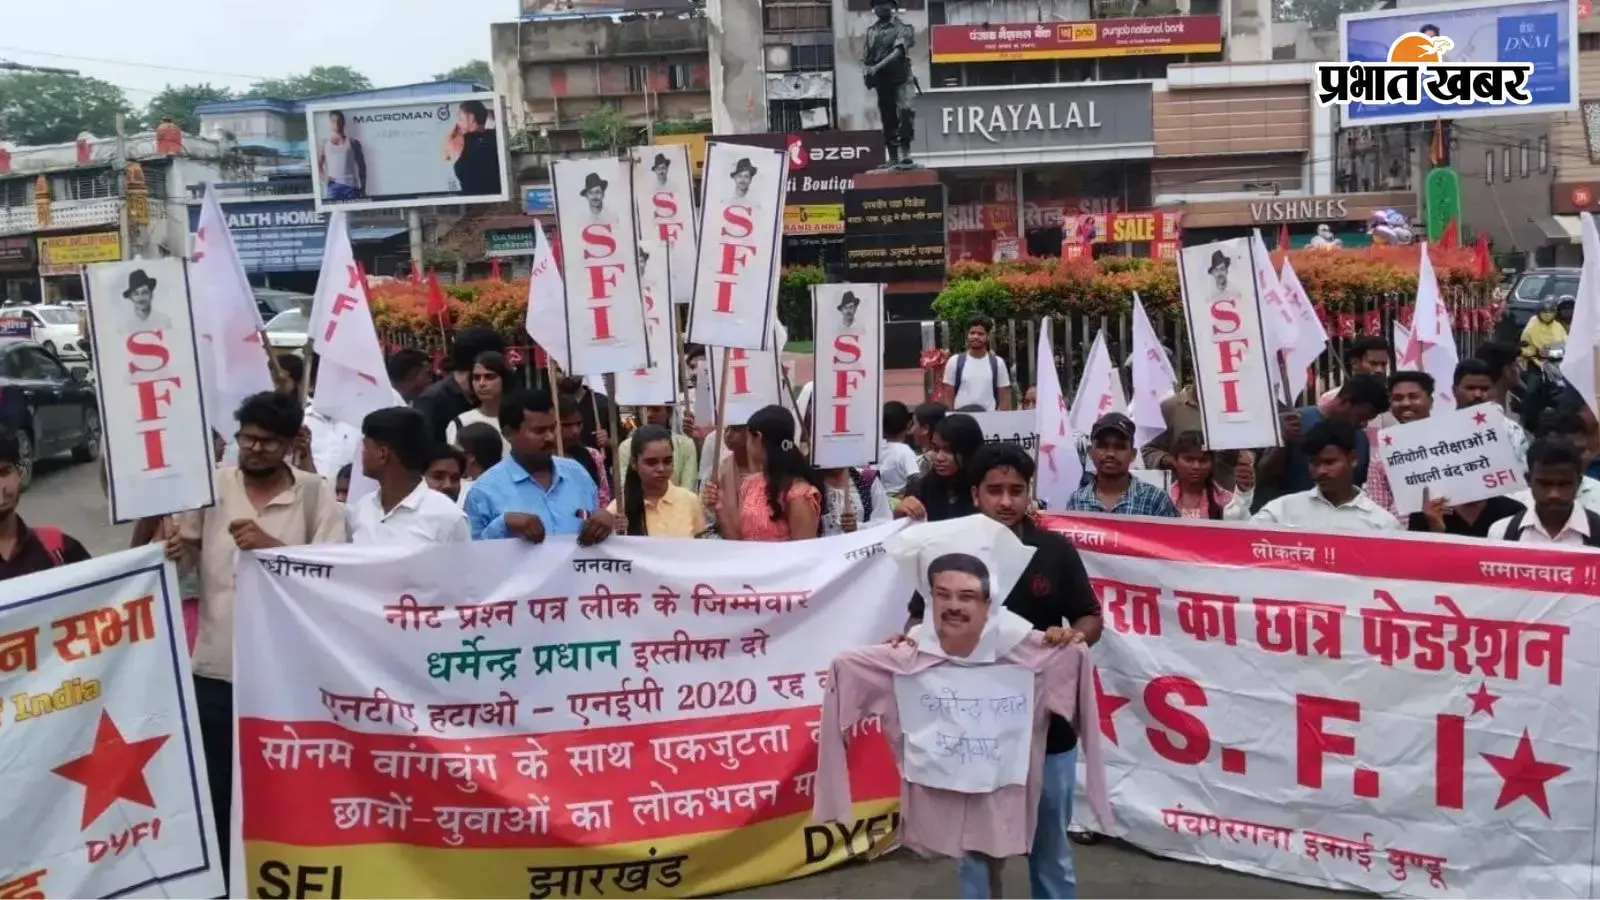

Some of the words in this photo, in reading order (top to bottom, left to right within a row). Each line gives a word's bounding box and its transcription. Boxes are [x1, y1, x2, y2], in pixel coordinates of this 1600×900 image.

[1164, 21, 1184, 33] bank
[353, 111, 433, 124] MACROMAN
[941, 101, 1102, 142] FIRAYALAL
[275, 211, 325, 225] HOME
[652, 191, 684, 242] SF
[949, 204, 985, 231] SALE
[1113, 217, 1156, 241] SALE
[1251, 199, 1348, 220] VISHNEES
[711, 204, 757, 314] SFI
[581, 223, 626, 342] SFI
[1210, 299, 1249, 414] SFI
[126, 329, 182, 472] SFI
[832, 334, 866, 434] SFI
[1387, 446, 1428, 467] प्रतियोगी
[1429, 432, 1485, 457] परीक्षाओं
[1486, 427, 1498, 443] में
[1442, 463, 1463, 480] बंद
[1463, 455, 1490, 474] करो
[1482, 468, 1517, 489] SFI
[258, 555, 334, 579] धीनता
[573, 558, 633, 574] जनवाद
[1252, 538, 1315, 561] लोकतंत्र
[1479, 561, 1575, 584] समाजवाद
[52, 595, 156, 662] सभा
[384, 593, 445, 631] नीट
[456, 600, 518, 630] प्रश्न
[528, 596, 569, 624] पत्र
[579, 584, 642, 620] लीक
[652, 585, 681, 617] के
[691, 583, 813, 617] जिम्मेवार
[427, 635, 521, 682] धर्मेन्द्र
[533, 639, 621, 677] प्रधान
[631, 628, 731, 672] इस्तीफा
[740, 628, 771, 658] दो
[1173, 589, 1240, 648] का
[1252, 597, 1346, 660] छात्र
[1360, 589, 1571, 687] फेडरेशन
[11, 677, 101, 722] India
[319, 686, 416, 733] एनटीए
[428, 690, 520, 732] हटाओ
[567, 676, 665, 727] एनईपी
[677, 677, 758, 711] 2020
[259, 725, 354, 769] सोनम
[370, 742, 497, 793] वांगचुंग
[512, 738, 549, 780] के
[566, 741, 635, 777] साथ
[650, 724, 791, 775] एकजुटता
[1144, 674, 1247, 776] S.
[1295, 692, 1380, 798] F.
[1435, 713, 1465, 810] I
[566, 800, 613, 833] का
[628, 780, 780, 828] लोकभवन
[86, 818, 161, 863] DYFI
[1160, 803, 1294, 852] पंचपरगना
[1302, 831, 1375, 872] इकाई
[257, 860, 343, 900] SFI
[527, 846, 688, 900] झारखंड
